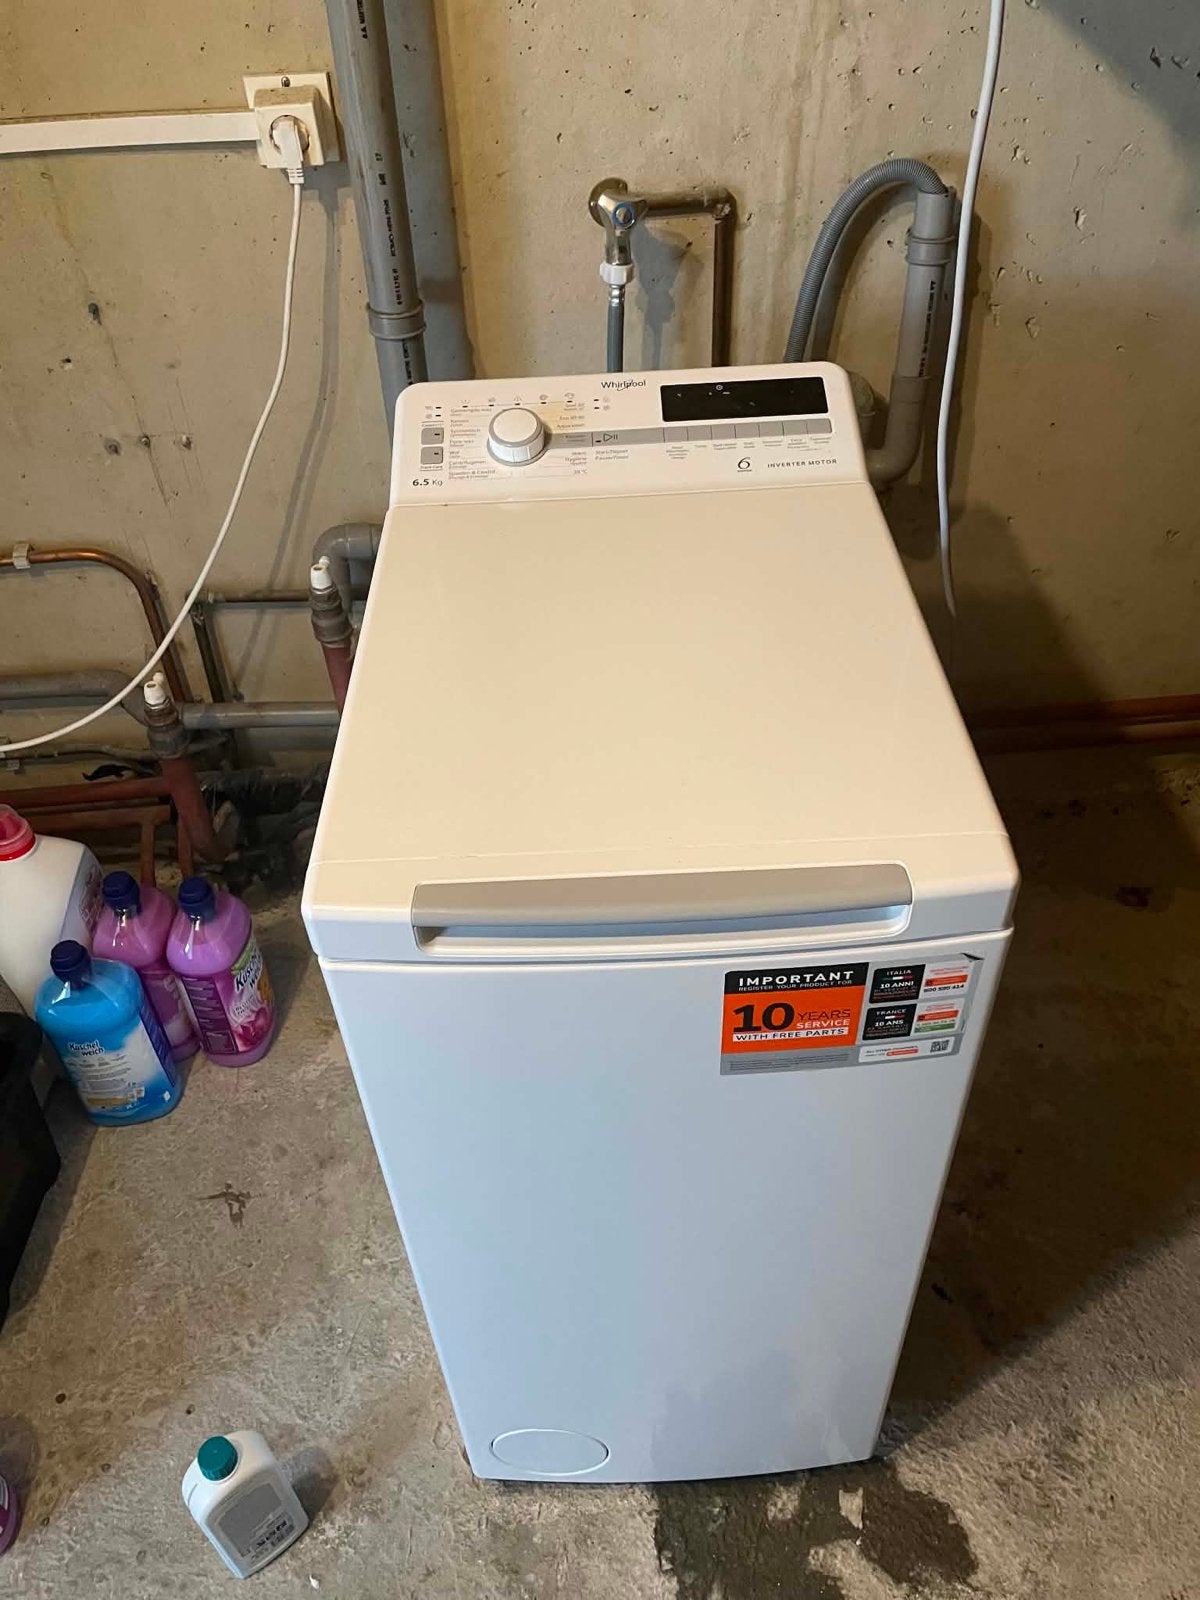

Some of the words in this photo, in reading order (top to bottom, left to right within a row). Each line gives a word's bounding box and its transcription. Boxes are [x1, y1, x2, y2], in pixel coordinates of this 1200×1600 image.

[601, 379, 646, 391] Whirlpool
[737, 456, 751, 470] 6
[808, 458, 837, 466] MOTOR
[412, 478, 430, 487] 6.5
[432, 479, 444, 487] Kg
[739, 971, 854, 986] IMPORTANT
[733, 1002, 795, 1033] 10
[797, 1009, 851, 1021] YEARS
[796, 1018, 850, 1029] SERVICE
[772, 1031, 801, 1039] FREE
[805, 1028, 845, 1036] PARTS
[81, 1047, 104, 1056] weich
